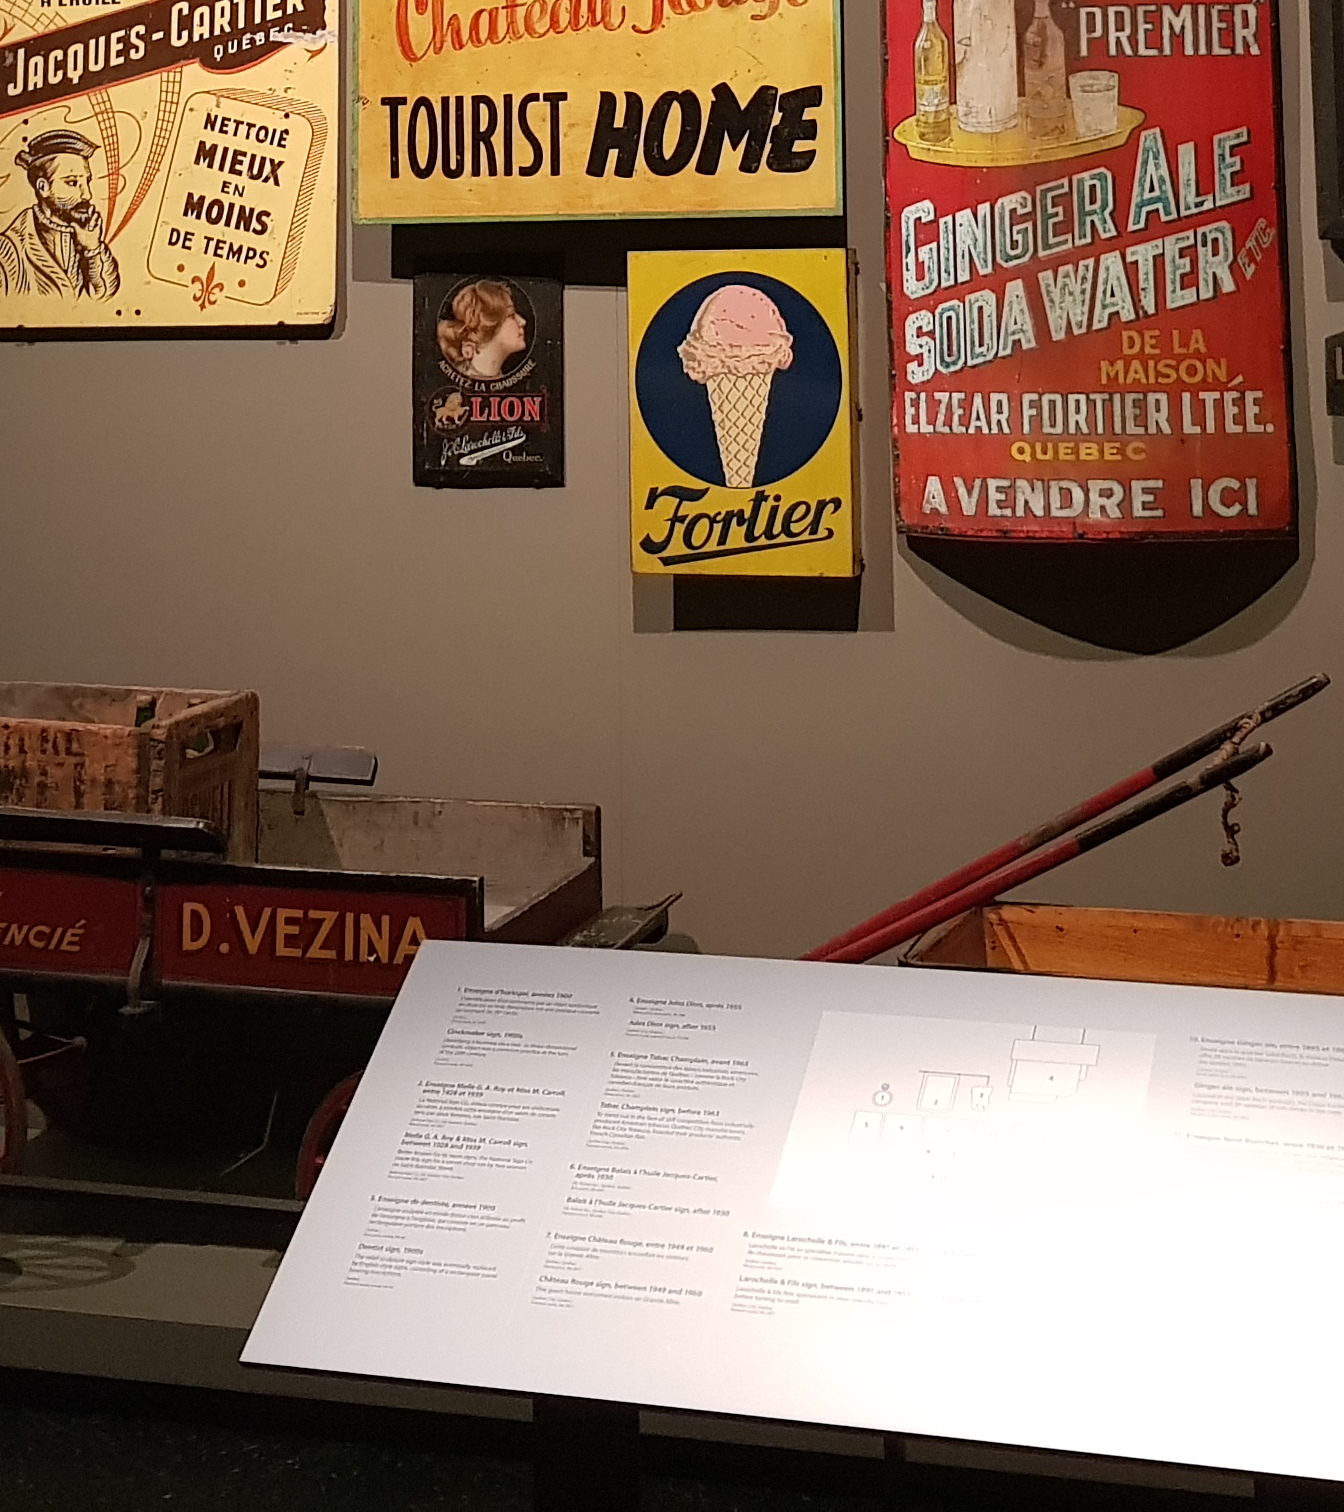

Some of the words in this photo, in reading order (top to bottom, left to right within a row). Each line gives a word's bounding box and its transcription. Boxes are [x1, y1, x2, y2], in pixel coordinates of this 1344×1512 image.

[203, 112, 290, 149] NETTOIE
[380, 91, 569, 180] TOURIST
[585, 81, 823, 179] HOME
[194, 139, 286, 187] MIEUX
[221, 180, 246, 198] EN
[182, 191, 273, 236] MOINS
[900, 166, 1117, 300] GINGER
[1126, 126, 1252, 233] ALE
[167, 227, 194, 251] DE
[203, 234, 272, 269] TEMPS
[903, 278, 1038, 386] SODA
[1037, 219, 1238, 343] WATER
[1121, 328, 1161, 356] DE
[1171, 328, 1208, 355] LA
[474, 382, 487, 393] LA
[1099, 357, 1230, 387] MAISON
[469, 395, 543, 422] LION
[903, 390, 1012, 434] ELZEAR
[1021, 390, 1173, 436] FORTIER
[1009, 439, 1150, 464] QUEBEC
[921, 474, 950, 516] A
[952, 475, 1166, 520] VENDRE
[1189, 476, 1260, 520] ICI
[639, 484, 843, 558] Fortier
